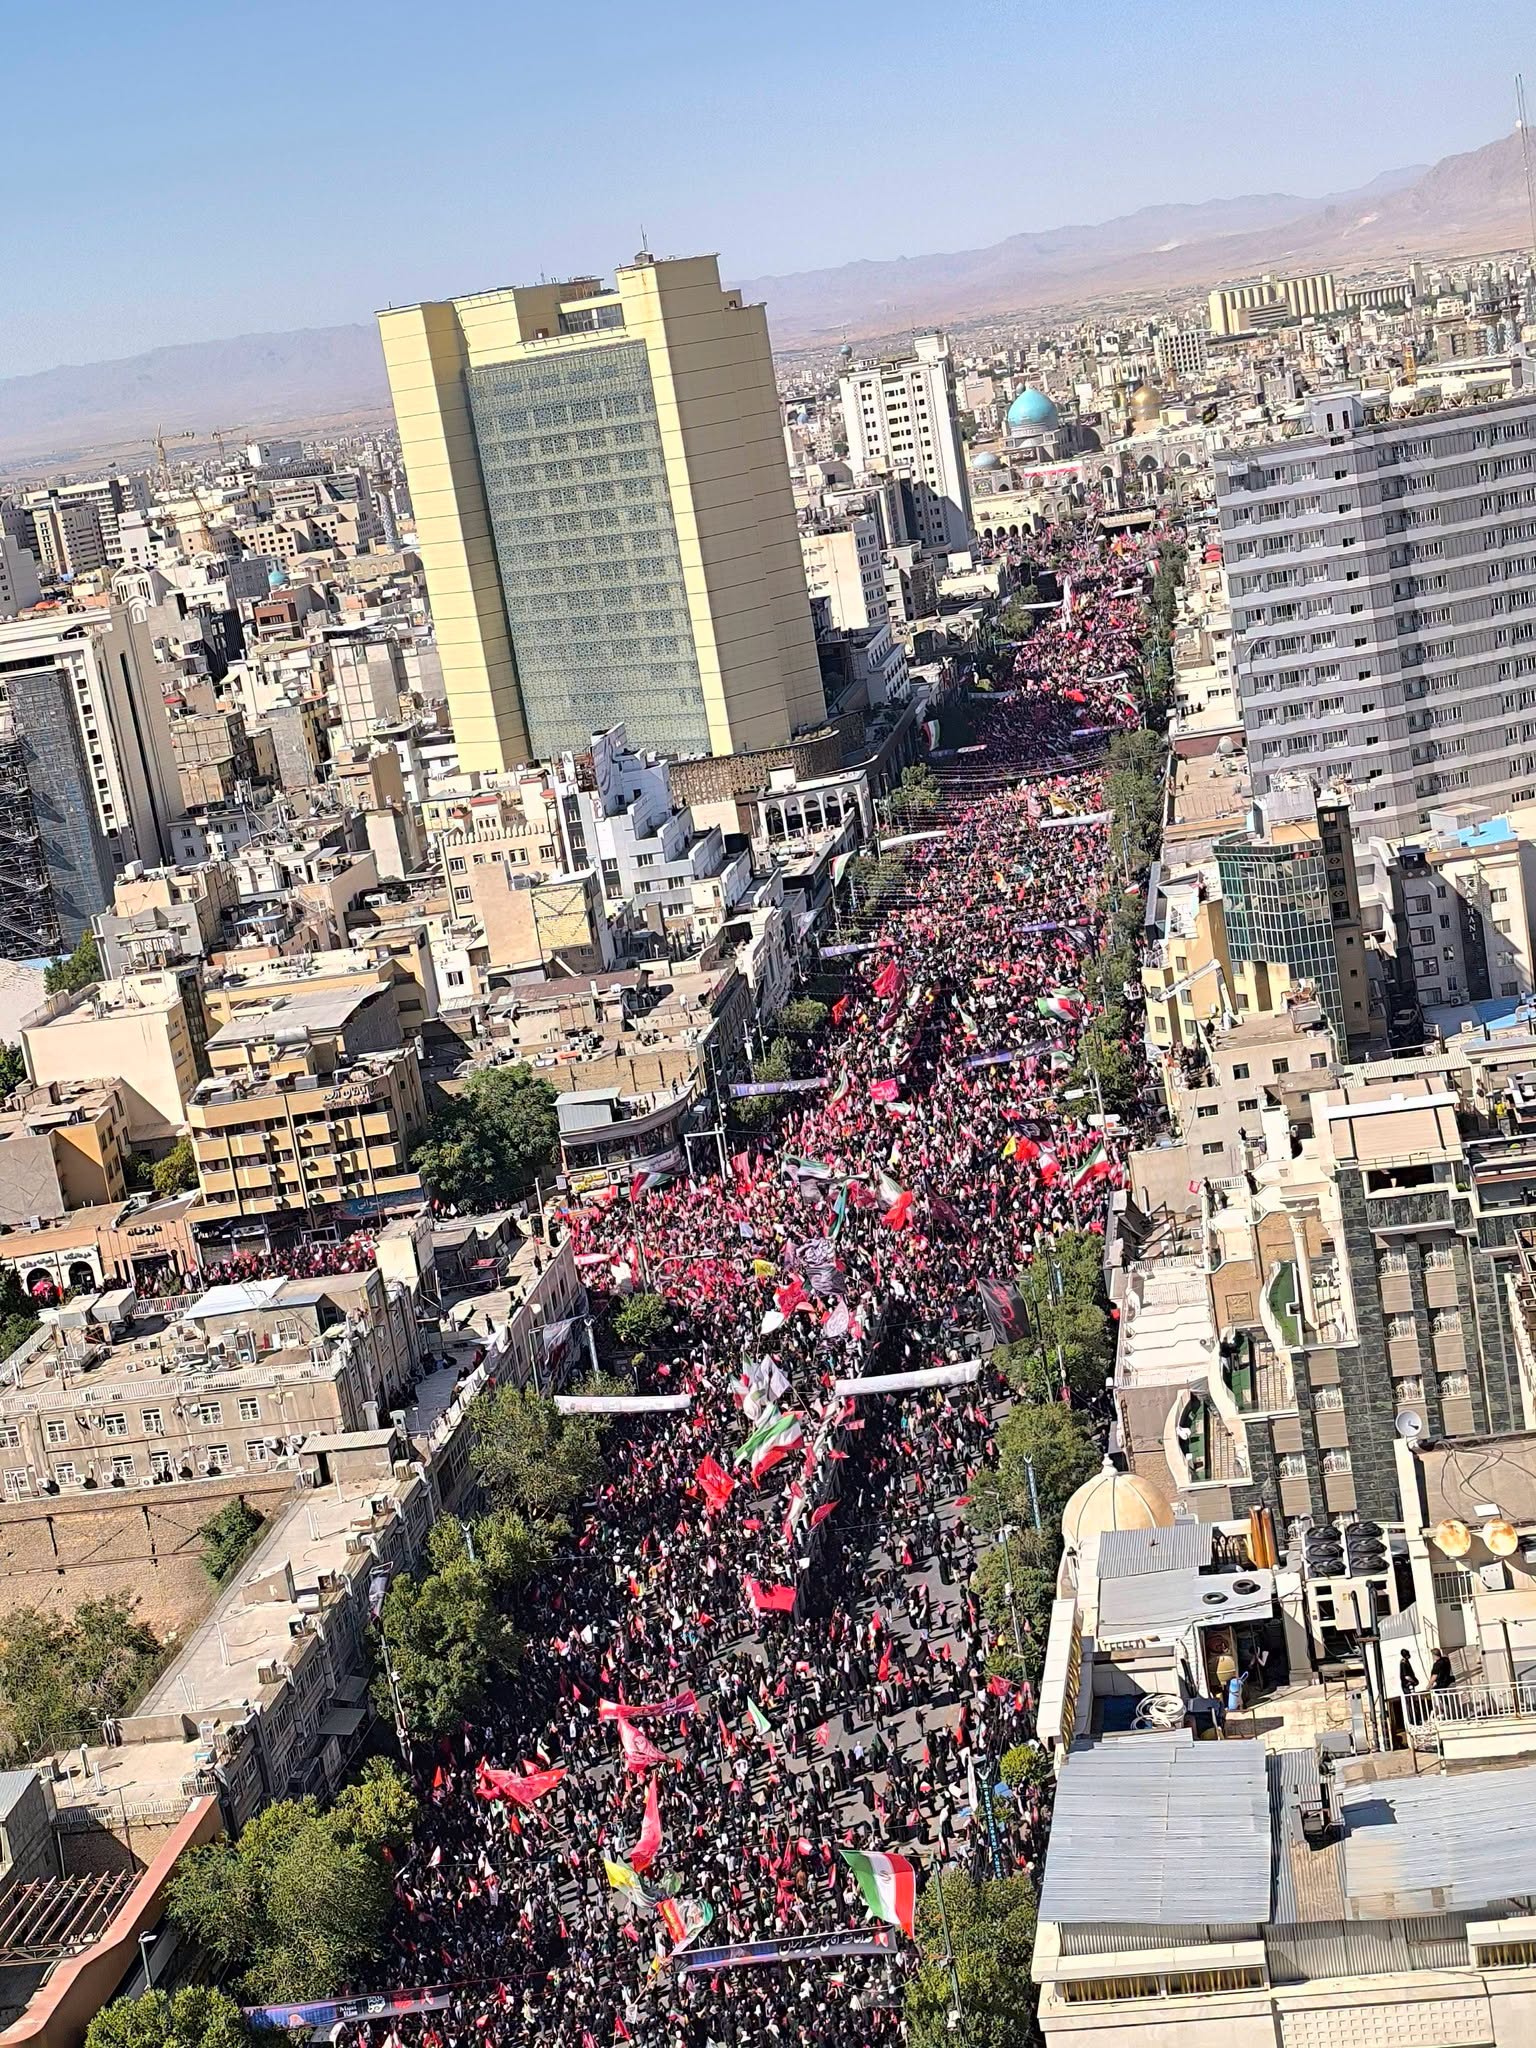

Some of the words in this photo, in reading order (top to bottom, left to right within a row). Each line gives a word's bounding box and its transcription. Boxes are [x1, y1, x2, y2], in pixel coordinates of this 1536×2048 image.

[127, 1224, 162, 1236] داروخانه
[804, 1935, 821, 1954] شهید
[842, 1932, 873, 1945] خداحافظ
[779, 1939, 802, 1956] ایران
